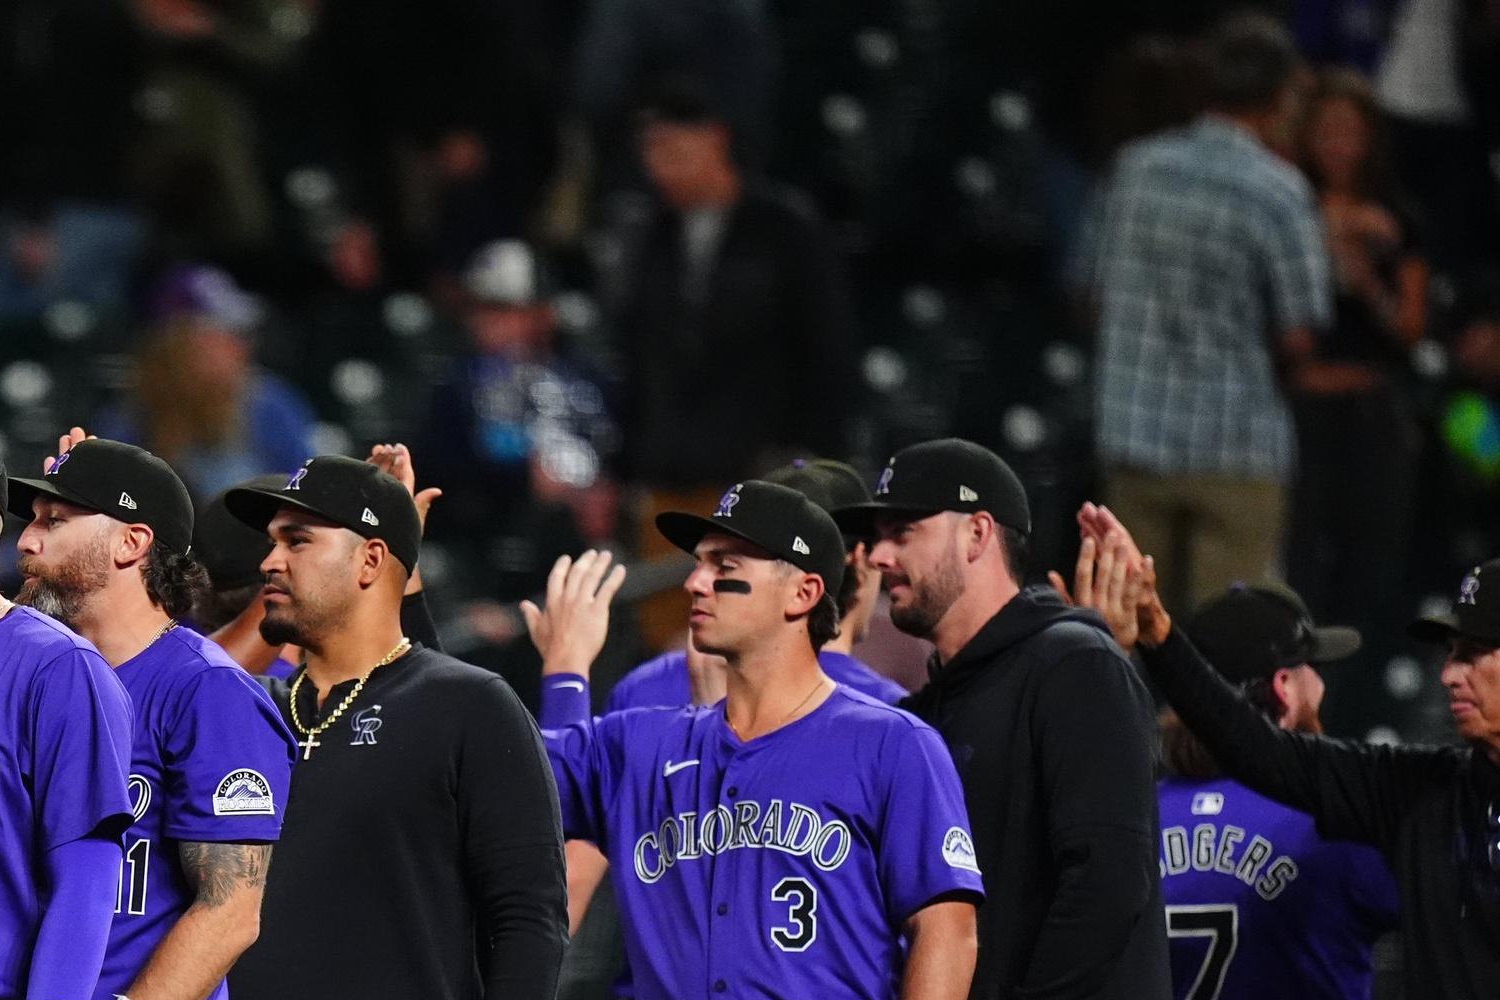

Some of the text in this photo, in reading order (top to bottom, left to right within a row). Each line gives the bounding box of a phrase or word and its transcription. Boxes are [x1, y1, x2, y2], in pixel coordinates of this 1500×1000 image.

[218, 771, 268, 795] COLORADO
[113, 838, 151, 916] 1
[633, 798, 852, 884] COLORADO
[1159, 822, 1299, 901] DGERS
[770, 876, 818, 953] 3
